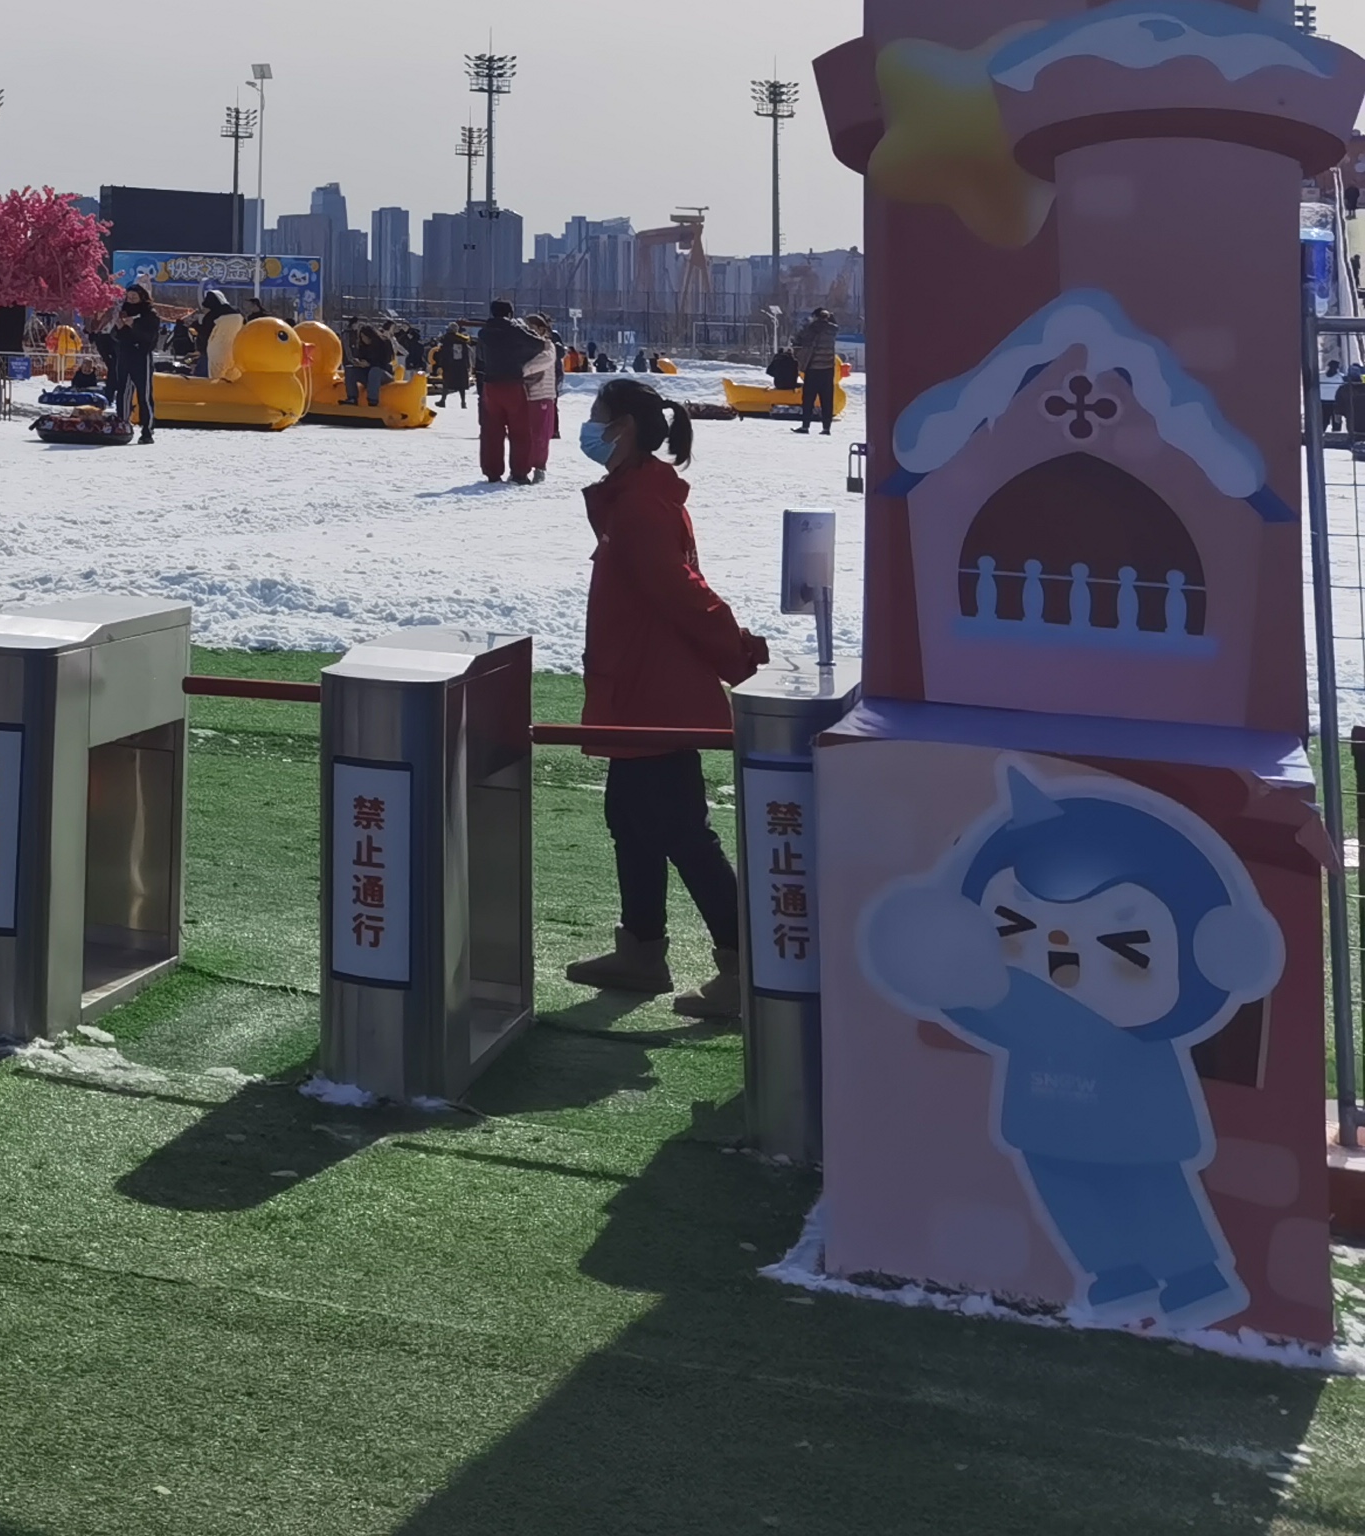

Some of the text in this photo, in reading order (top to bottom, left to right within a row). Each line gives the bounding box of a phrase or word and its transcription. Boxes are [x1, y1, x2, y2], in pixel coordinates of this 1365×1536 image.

[352, 795, 385, 948] 禁止通行
[766, 801, 810, 961] 禁止通行
